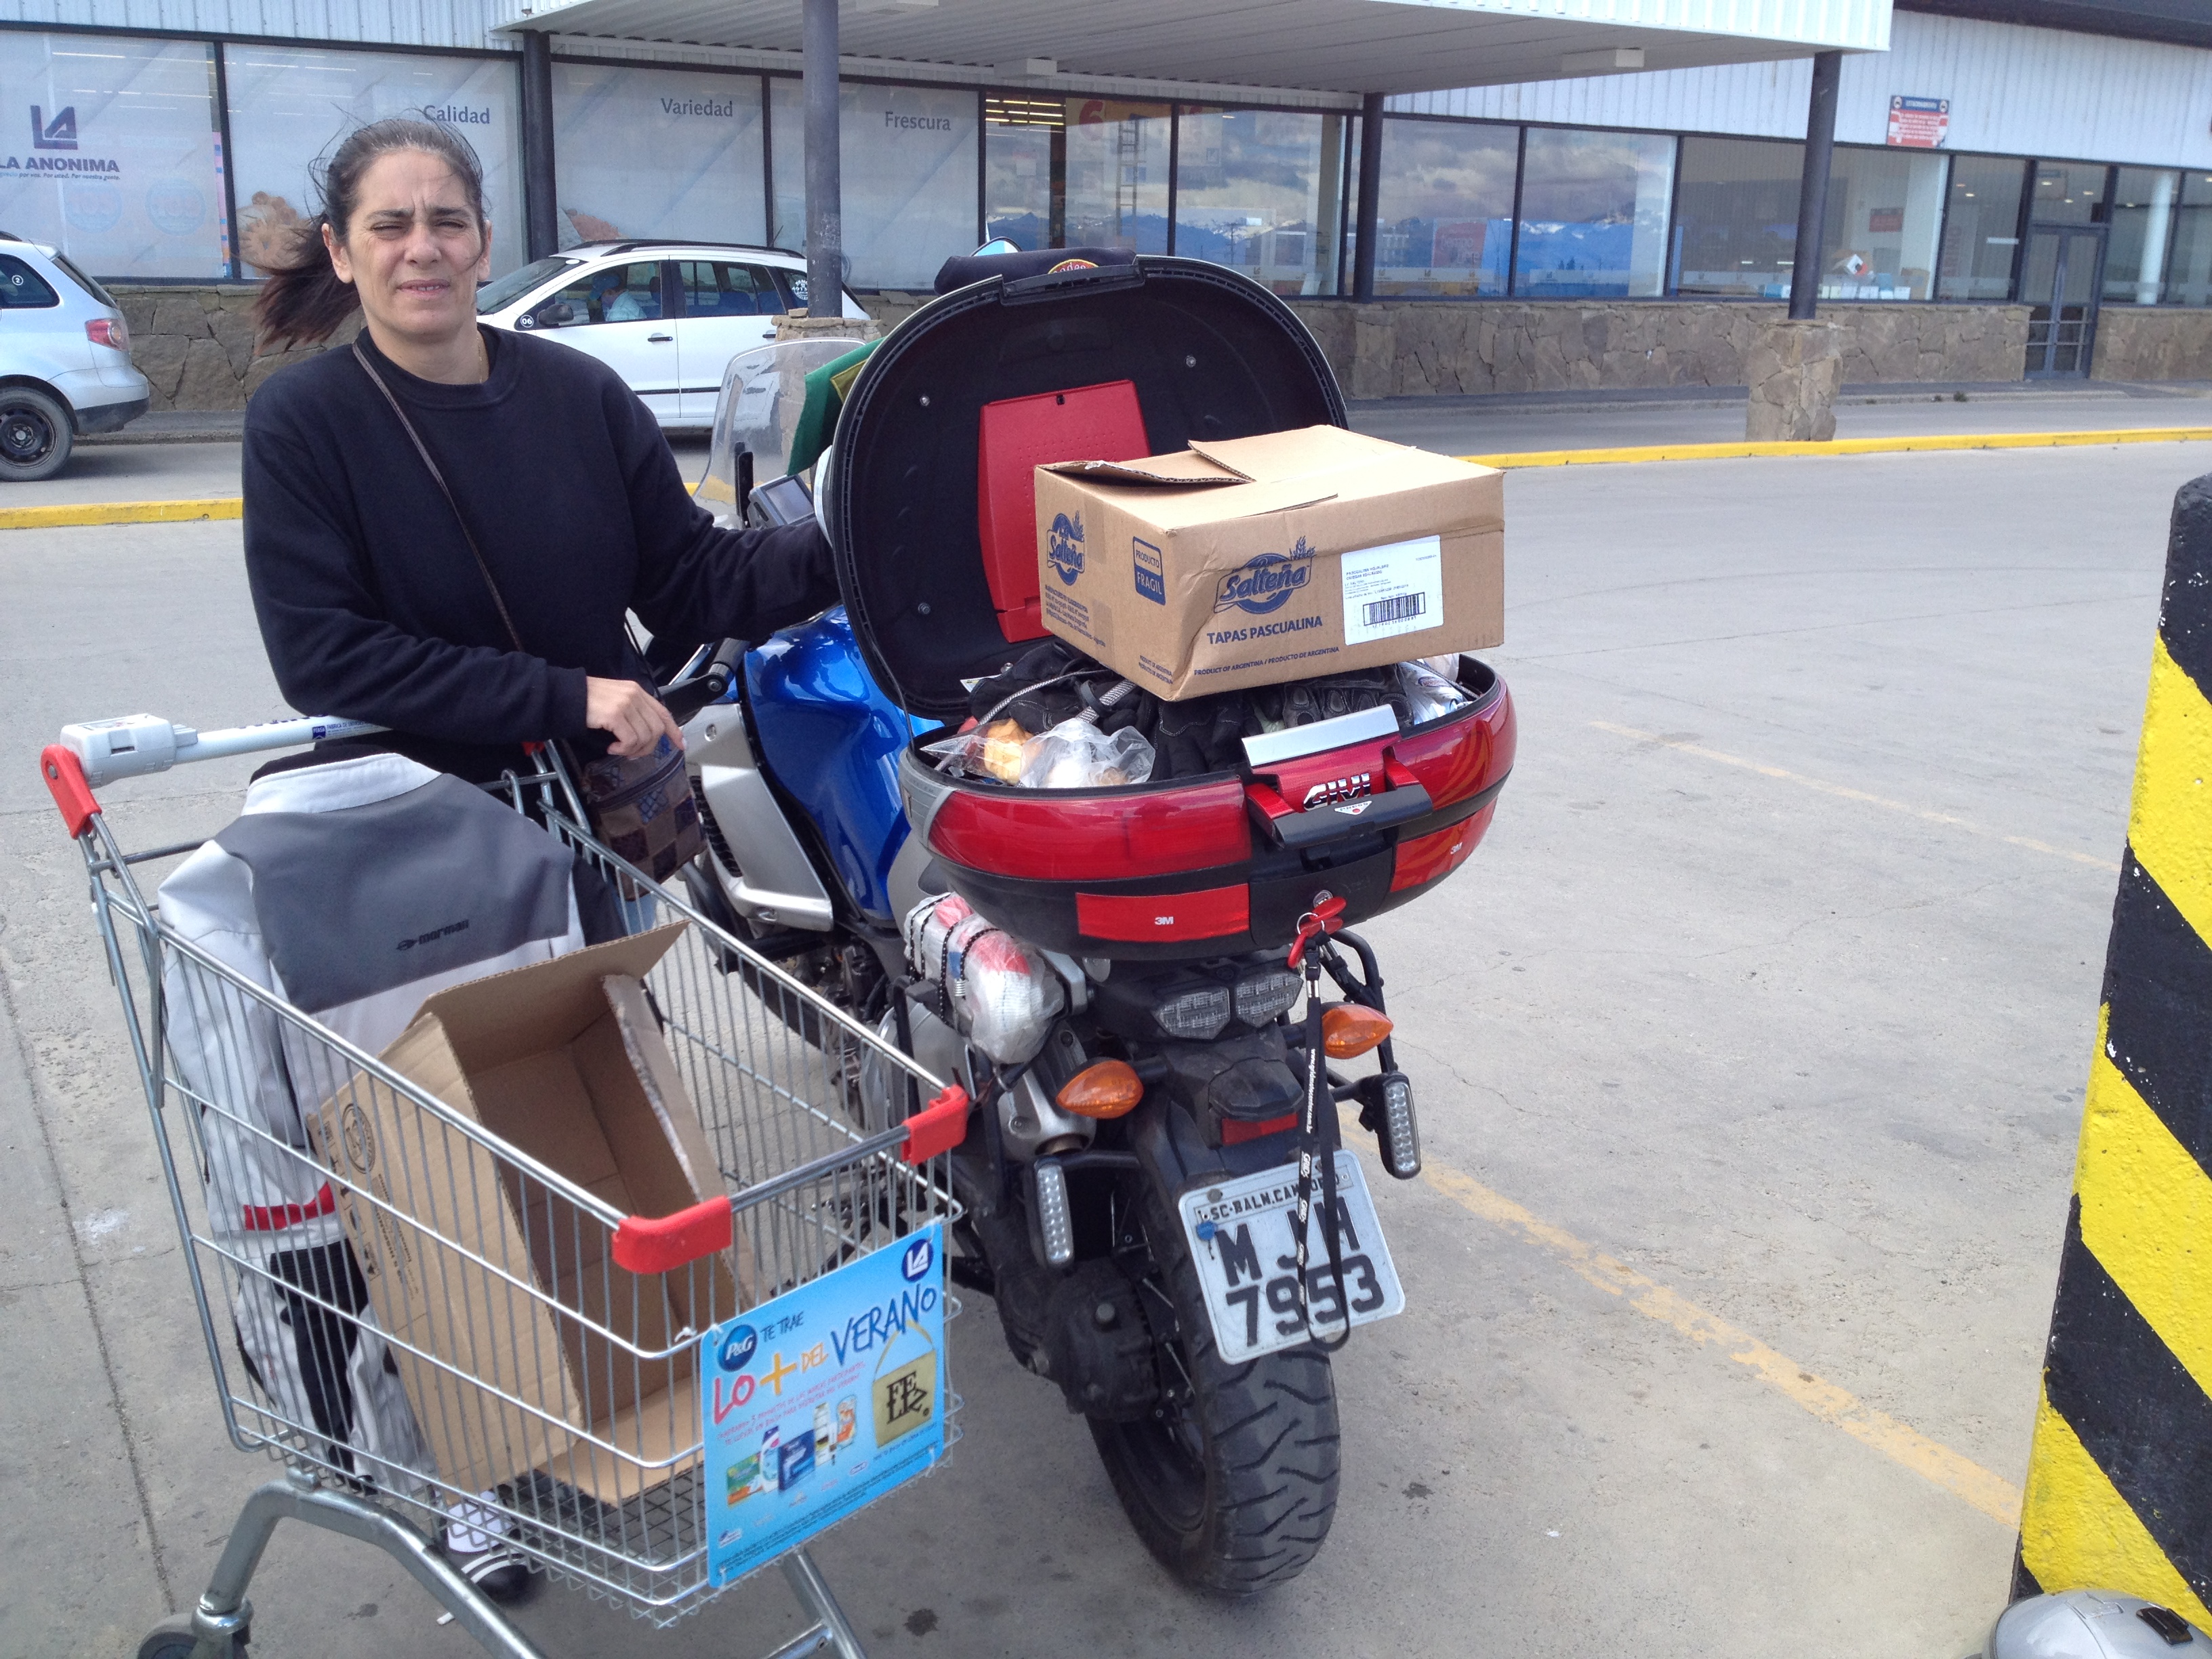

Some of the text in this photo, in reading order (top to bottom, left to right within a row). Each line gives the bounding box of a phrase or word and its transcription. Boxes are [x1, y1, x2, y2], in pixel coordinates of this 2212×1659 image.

[424, 105, 490, 124] Calidad
[661, 98, 733, 117] Variedad
[885, 111, 951, 131] Frescura
[26, 157, 120, 172] ANONIMA
[1049, 534, 1084, 571] Salteña
[1136, 549, 1160, 569] PRODUCTO
[1136, 571, 1163, 595] FRAGIL
[1220, 563, 1307, 602] Salteña
[1207, 615, 1323, 644] TAPAS PASCUALINA
[1194, 666, 1223, 676] PRODUCT
[1231, 659, 1264, 671] ARGENTINA
[1268, 653, 1299, 664] PRODUCTO
[1307, 647, 1340, 657] ARGENTINA
[1303, 773, 1372, 811] GIVI
[1450, 842, 1462, 855] 3M
[1155, 916, 1174, 925] 3M
[1225, 1254, 1385, 1347] 7953
[760, 1311, 805, 1343] TE TRAE
[714, 1374, 756, 1425] LO
[801, 1341, 829, 1374] DEL
[830, 1283, 937, 1367] VERANO
[724, 1334, 754, 1361] P&G
